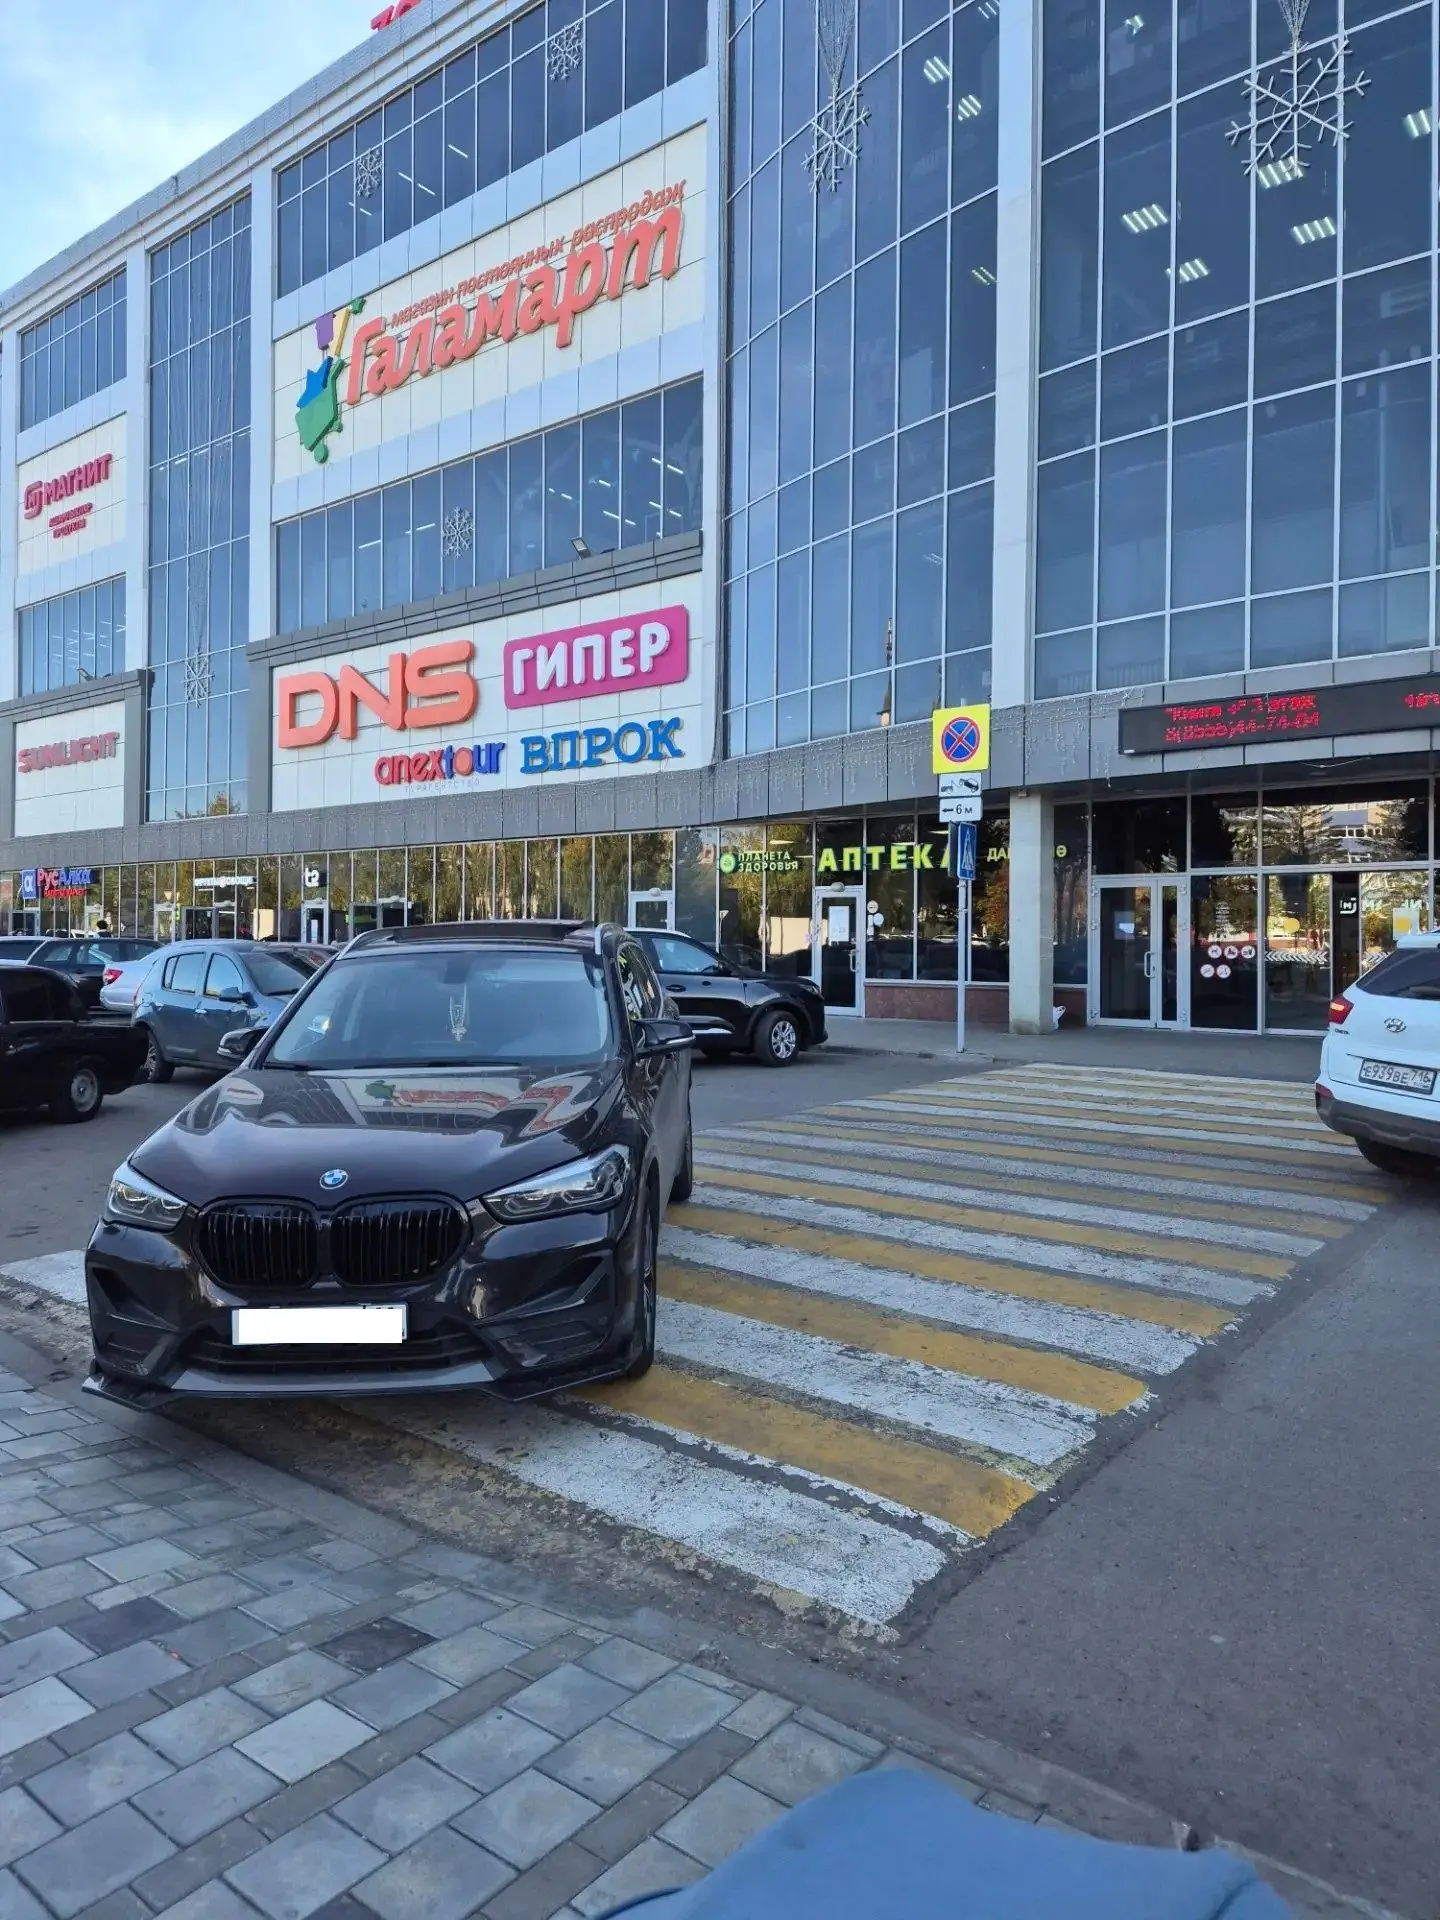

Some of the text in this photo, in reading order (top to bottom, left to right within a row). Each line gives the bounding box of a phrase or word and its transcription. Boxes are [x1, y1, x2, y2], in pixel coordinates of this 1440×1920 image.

[346, 206, 685, 405] Галамарт
[43, 453, 113, 506] МАГНИТ
[511, 621, 671, 696] ГИПЕР
[278, 640, 478, 748] DNS
[519, 717, 685, 774] ВПРОК
[955, 803, 963, 815] 6
[738, 850, 791, 862] ПЛАНЕТА
[738, 860, 799, 873] ЗДОРОВЬЯ
